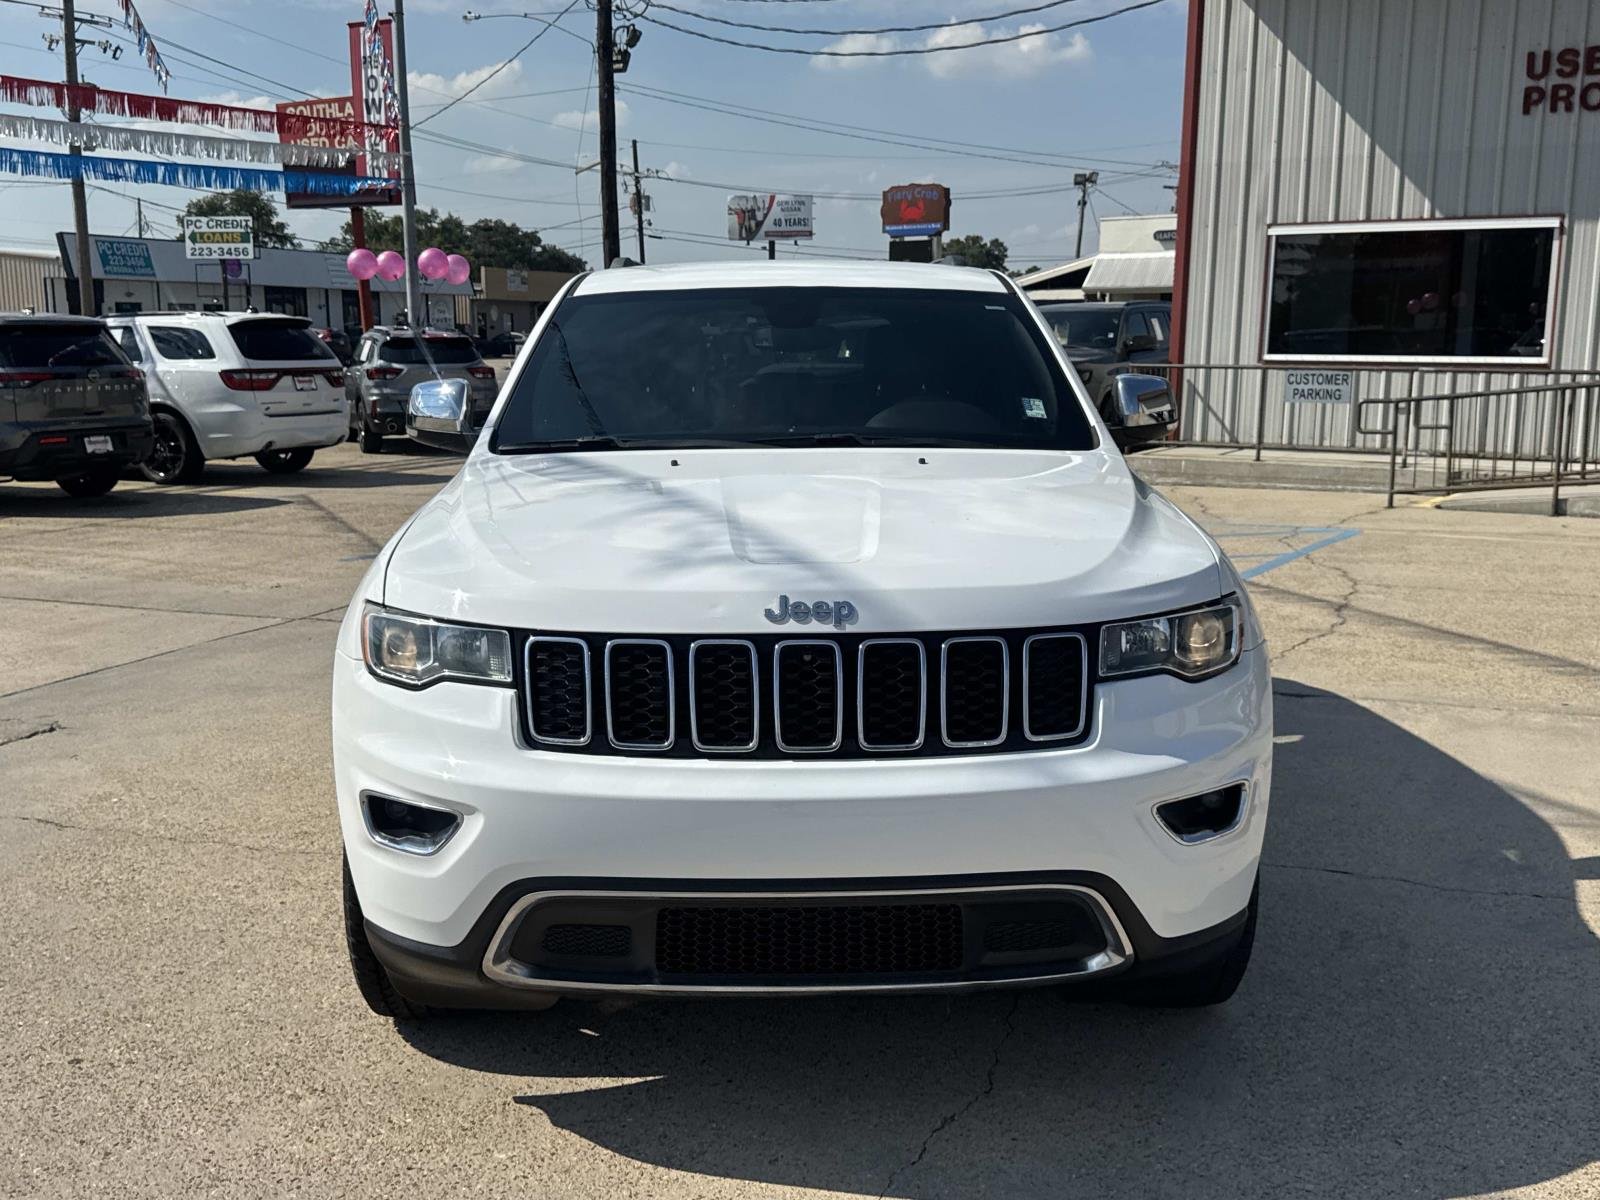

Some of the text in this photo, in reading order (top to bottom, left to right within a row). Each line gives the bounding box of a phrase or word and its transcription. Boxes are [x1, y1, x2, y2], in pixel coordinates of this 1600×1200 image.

[1526, 46, 1600, 81] USE
[185, 218, 251, 230] PC CREDIT
[773, 217, 809, 227] 40 YEARS!
[196, 232, 242, 243] LOANS
[97, 241, 149, 257] PC CREDIT
[1287, 372, 1350, 386] CUSTOMER
[1292, 387, 1343, 401] PARKING
[764, 594, 856, 627] Jeep
